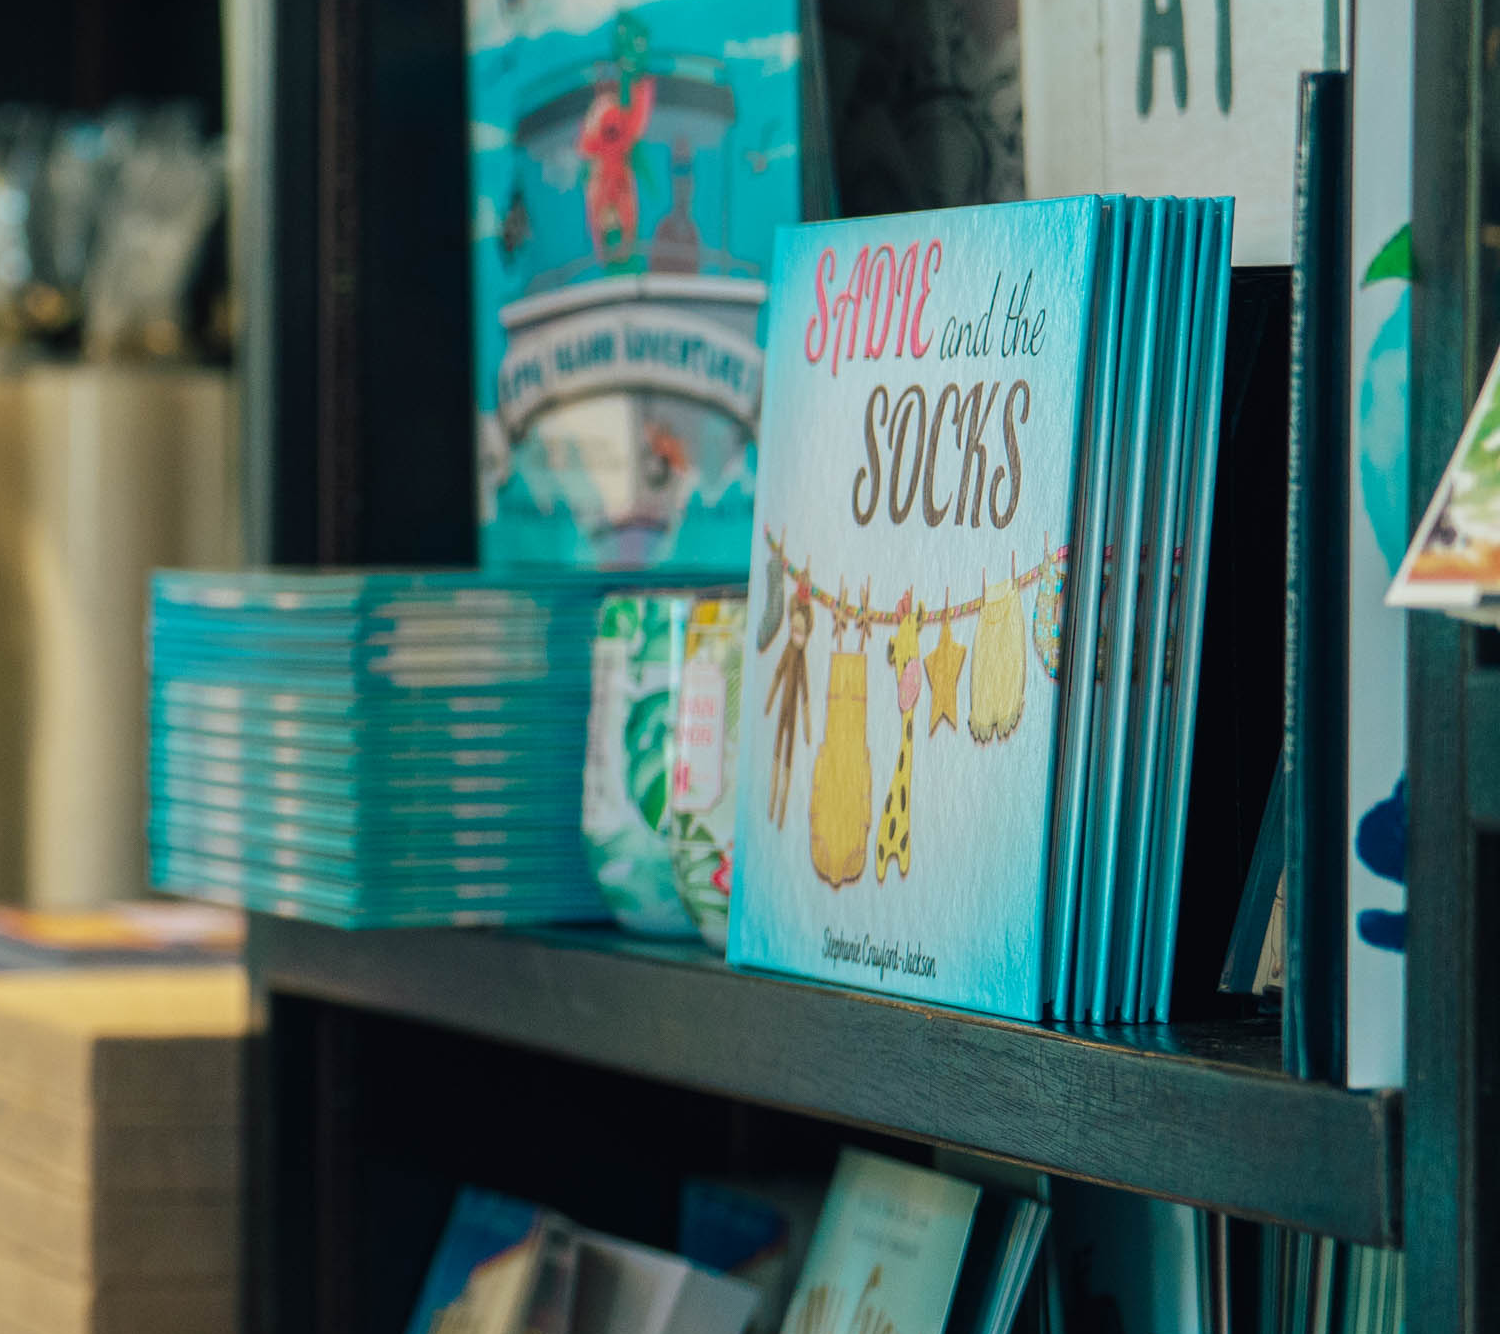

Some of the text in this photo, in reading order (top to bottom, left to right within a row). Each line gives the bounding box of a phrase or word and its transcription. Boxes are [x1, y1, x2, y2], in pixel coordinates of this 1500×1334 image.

[805, 239, 1046, 377] SADIE and the
[852, 378, 1031, 530] SOCKS
[822, 926, 861, 969] Stephanie
